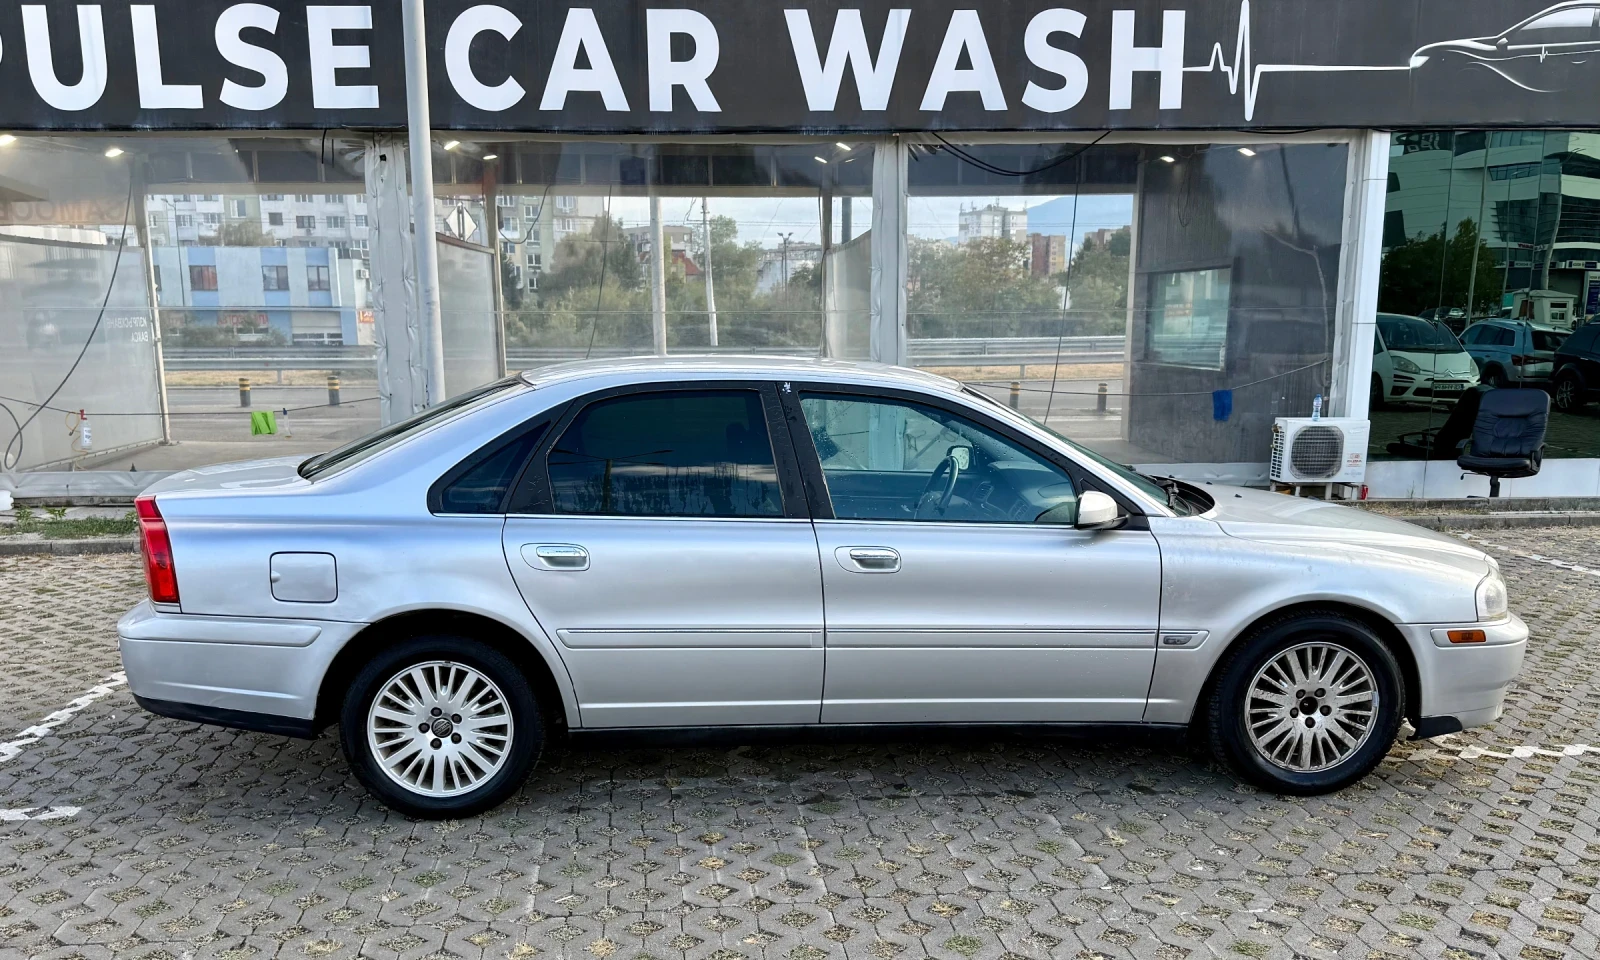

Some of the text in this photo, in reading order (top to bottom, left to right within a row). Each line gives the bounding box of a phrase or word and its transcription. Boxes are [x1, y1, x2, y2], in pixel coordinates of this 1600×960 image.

[0, 3, 1186, 113] ULSE CAR WASH
